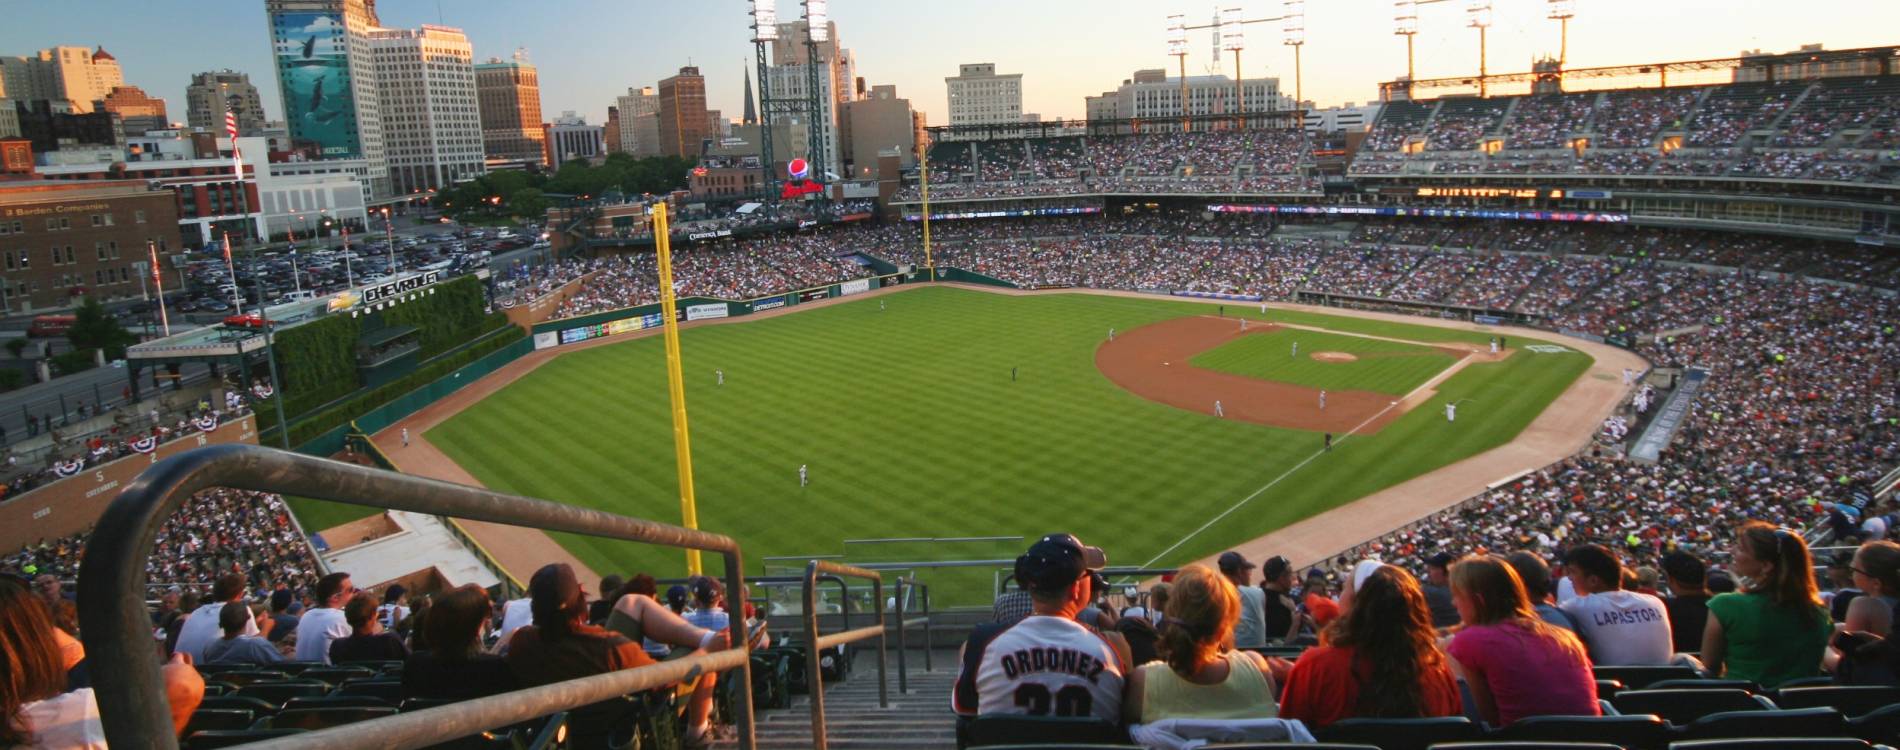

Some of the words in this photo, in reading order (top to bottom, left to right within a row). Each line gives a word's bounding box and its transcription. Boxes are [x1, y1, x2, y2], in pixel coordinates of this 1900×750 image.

[16, 207, 53, 216] Barden
[55, 203, 109, 213] Companies
[363, 269, 441, 303] CHEVROLET
[352, 288, 435, 318] FOUNTAIN
[198, 435, 207, 447] 16
[150, 452, 158, 464] 2
[96, 470, 104, 482] 5
[1001, 647, 1104, 685] ORDONEZ
